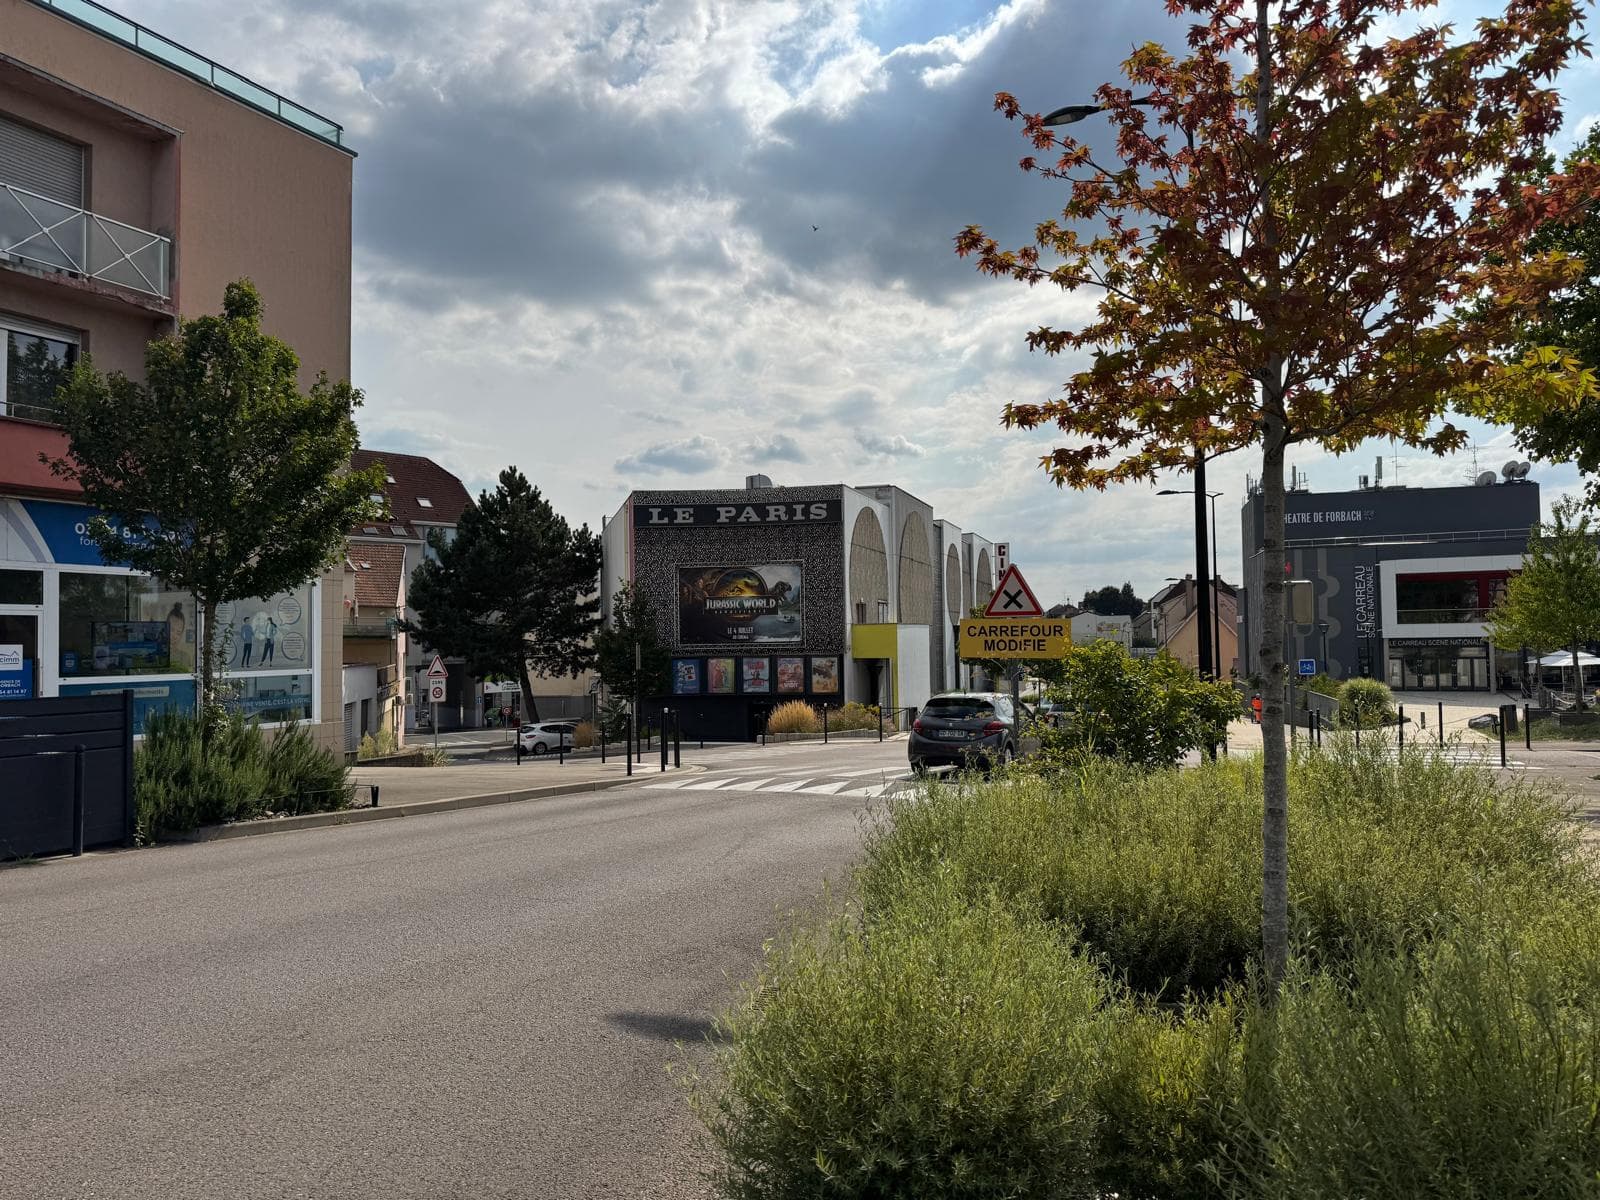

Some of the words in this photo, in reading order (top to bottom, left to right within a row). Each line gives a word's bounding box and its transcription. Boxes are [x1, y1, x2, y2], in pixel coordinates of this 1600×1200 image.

[649, 507, 694, 524] LE
[716, 503, 828, 523] PARIS
[1283, 512, 1311, 524] HEATRE
[1313, 512, 1324, 523] DE
[1325, 510, 1361, 522] FORBACH
[1354, 565, 1367, 622] CARREAU
[1366, 565, 1375, 610] NATIONALE
[705, 598, 741, 609] JURASSIC
[743, 598, 776, 609] WORLD
[967, 625, 1063, 637] CARREFOUR
[984, 639, 1046, 651] MODIFIE
